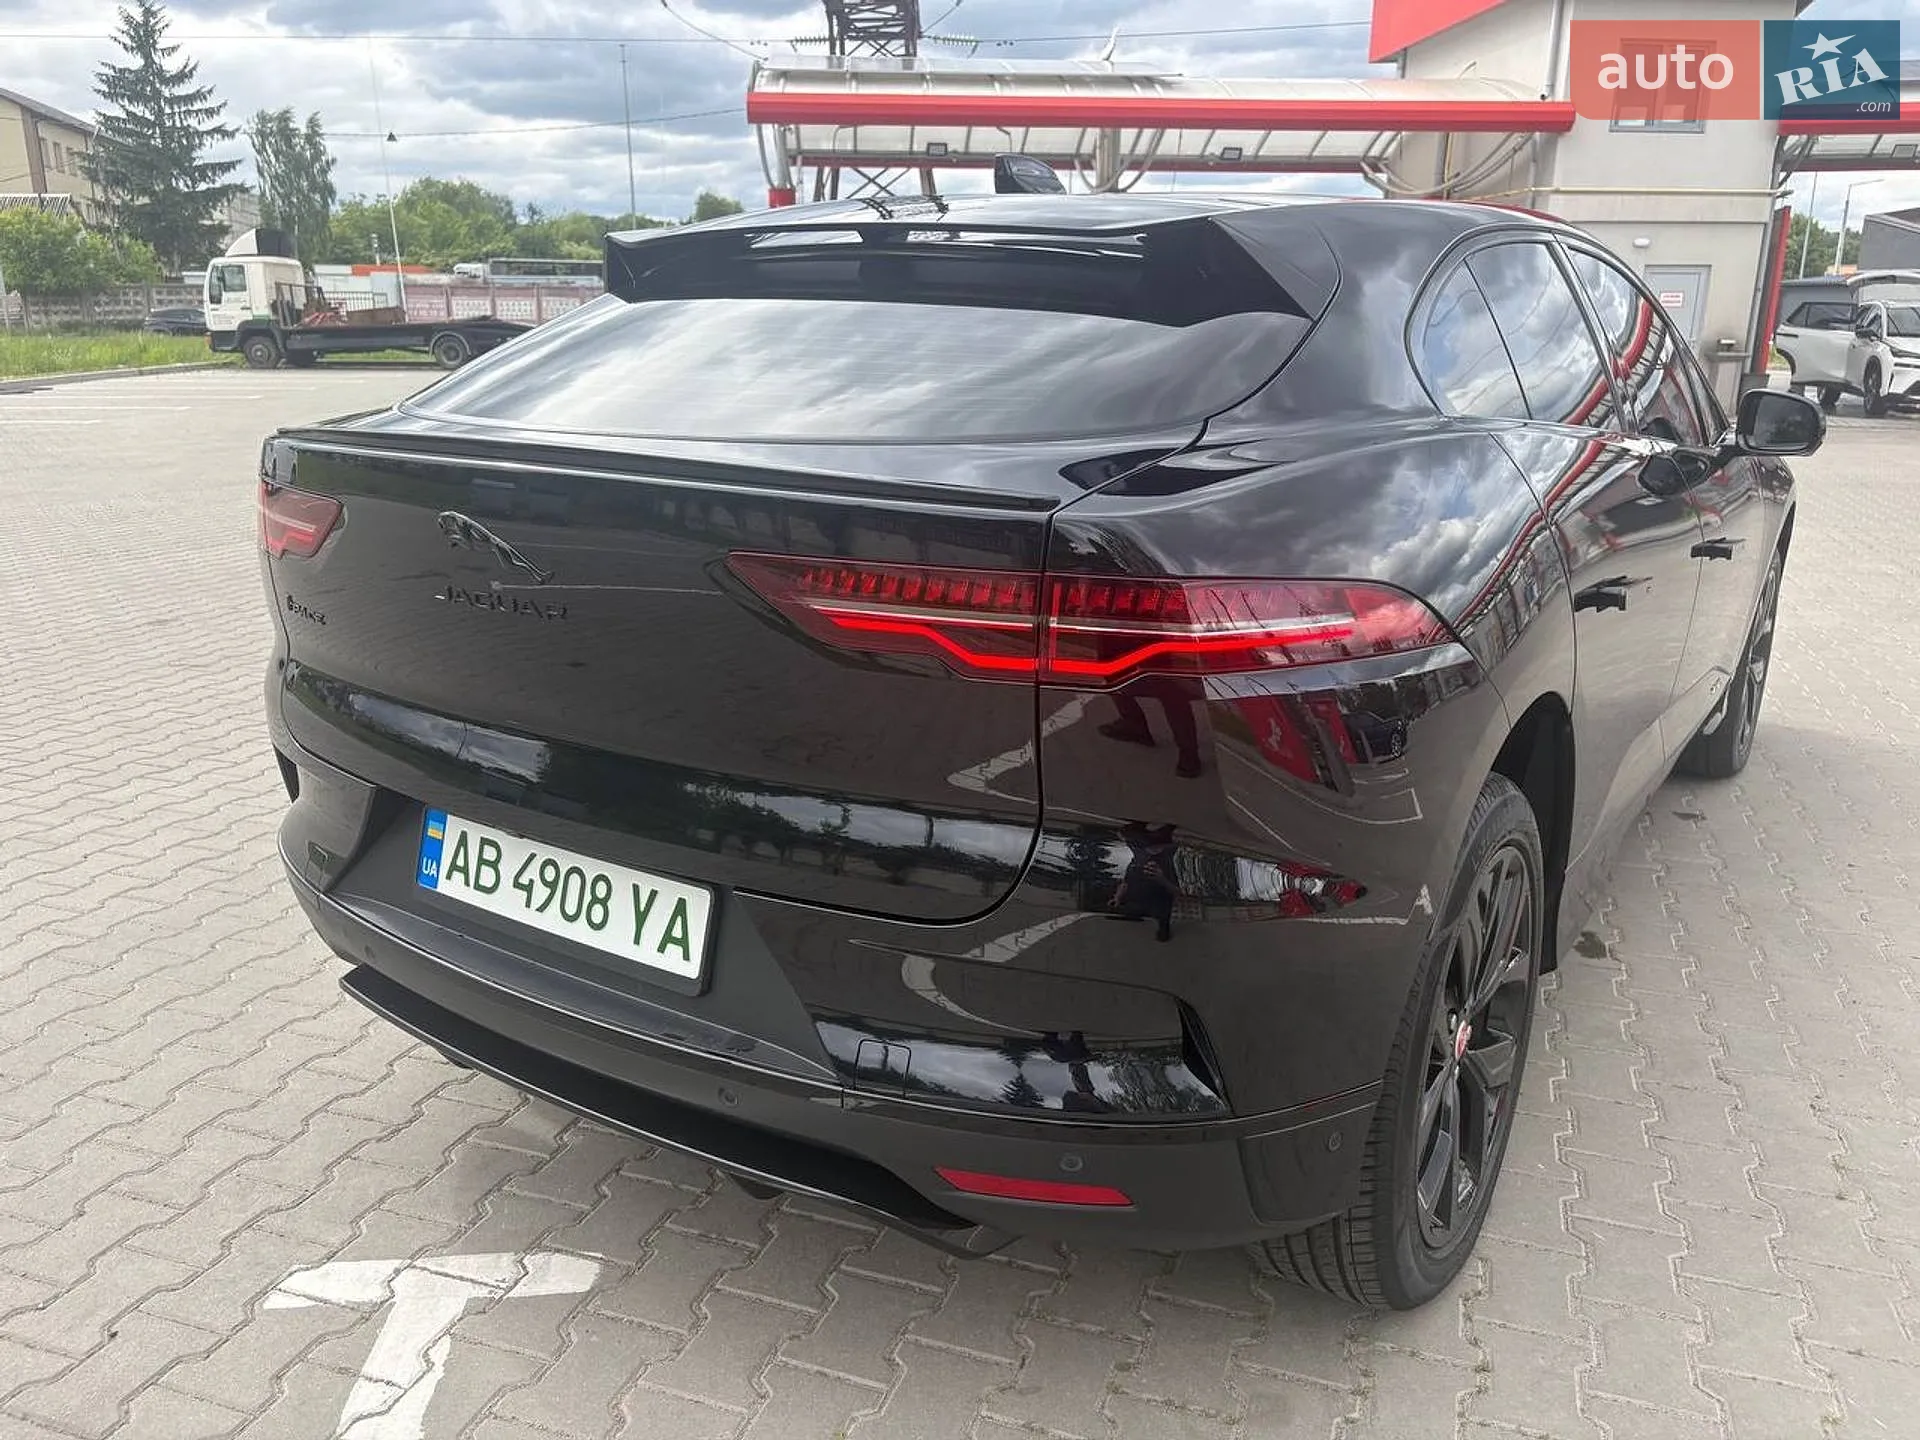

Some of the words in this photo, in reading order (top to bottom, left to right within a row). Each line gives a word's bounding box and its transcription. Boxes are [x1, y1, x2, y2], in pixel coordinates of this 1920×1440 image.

[433, 585, 568, 623] JAGUAR
[422, 856, 438, 877] UA
[445, 830, 502, 895] AB
[512, 852, 613, 931] 4908
[632, 883, 690, 961] YA
